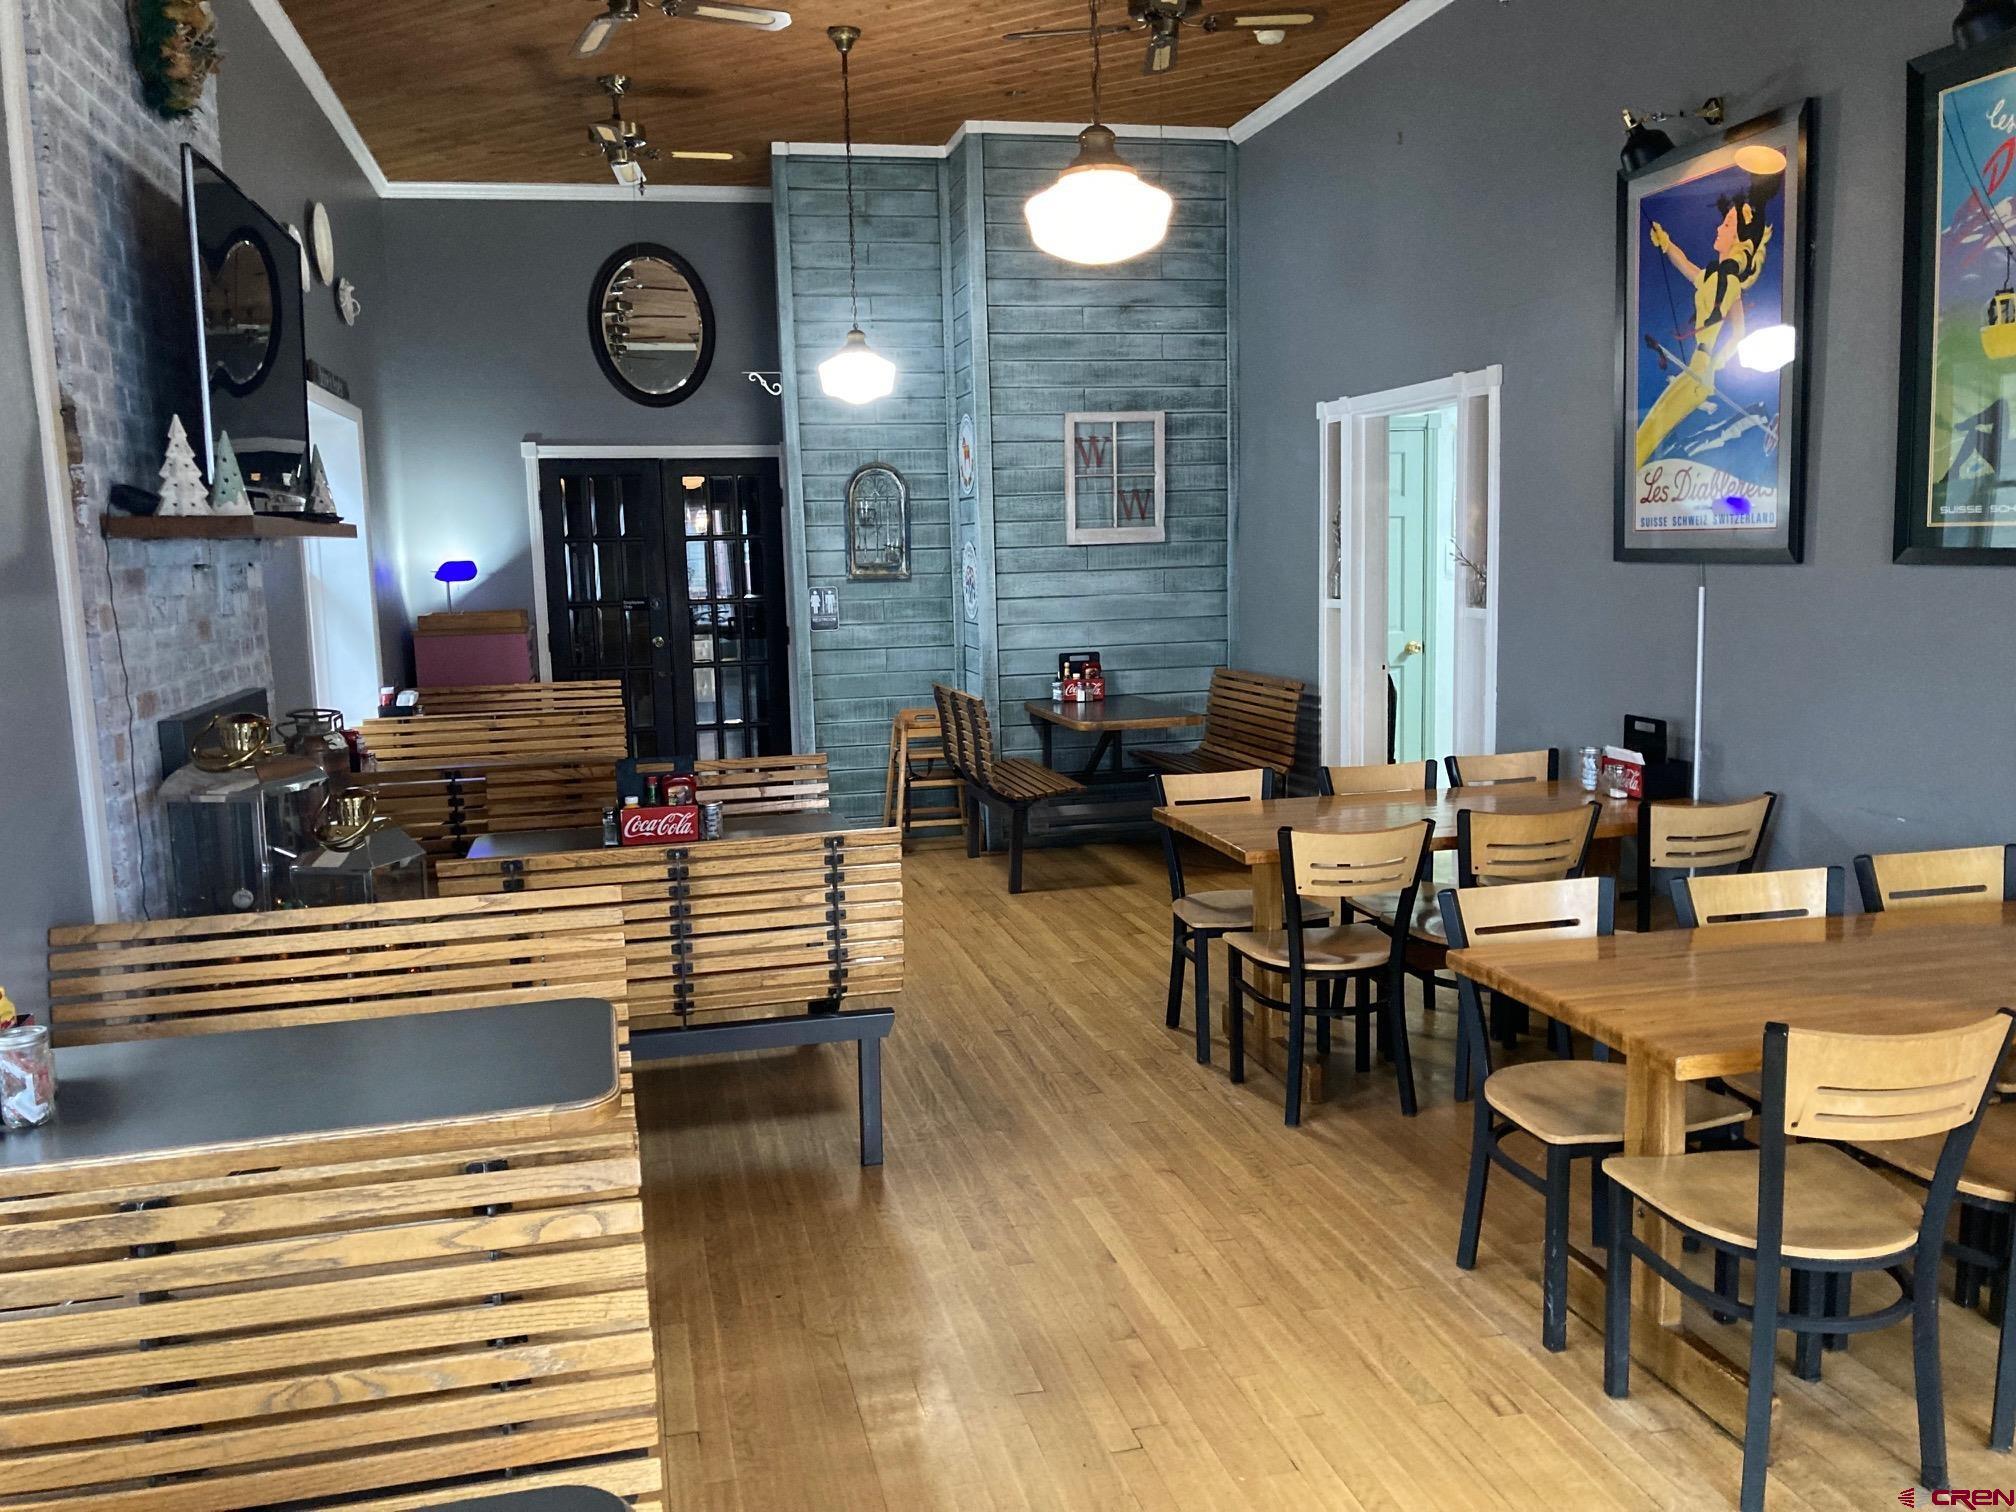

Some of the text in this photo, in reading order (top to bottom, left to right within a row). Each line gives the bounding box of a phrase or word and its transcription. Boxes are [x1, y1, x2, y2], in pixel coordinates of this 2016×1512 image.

[1075, 435, 1112, 468] W
[1640, 466, 1670, 504] Les
[1117, 489, 1153, 521] W
[1640, 511, 1776, 528] SUISSE SCHWEIZ SWITZERLAND
[1940, 504, 1983, 514] SUISSE
